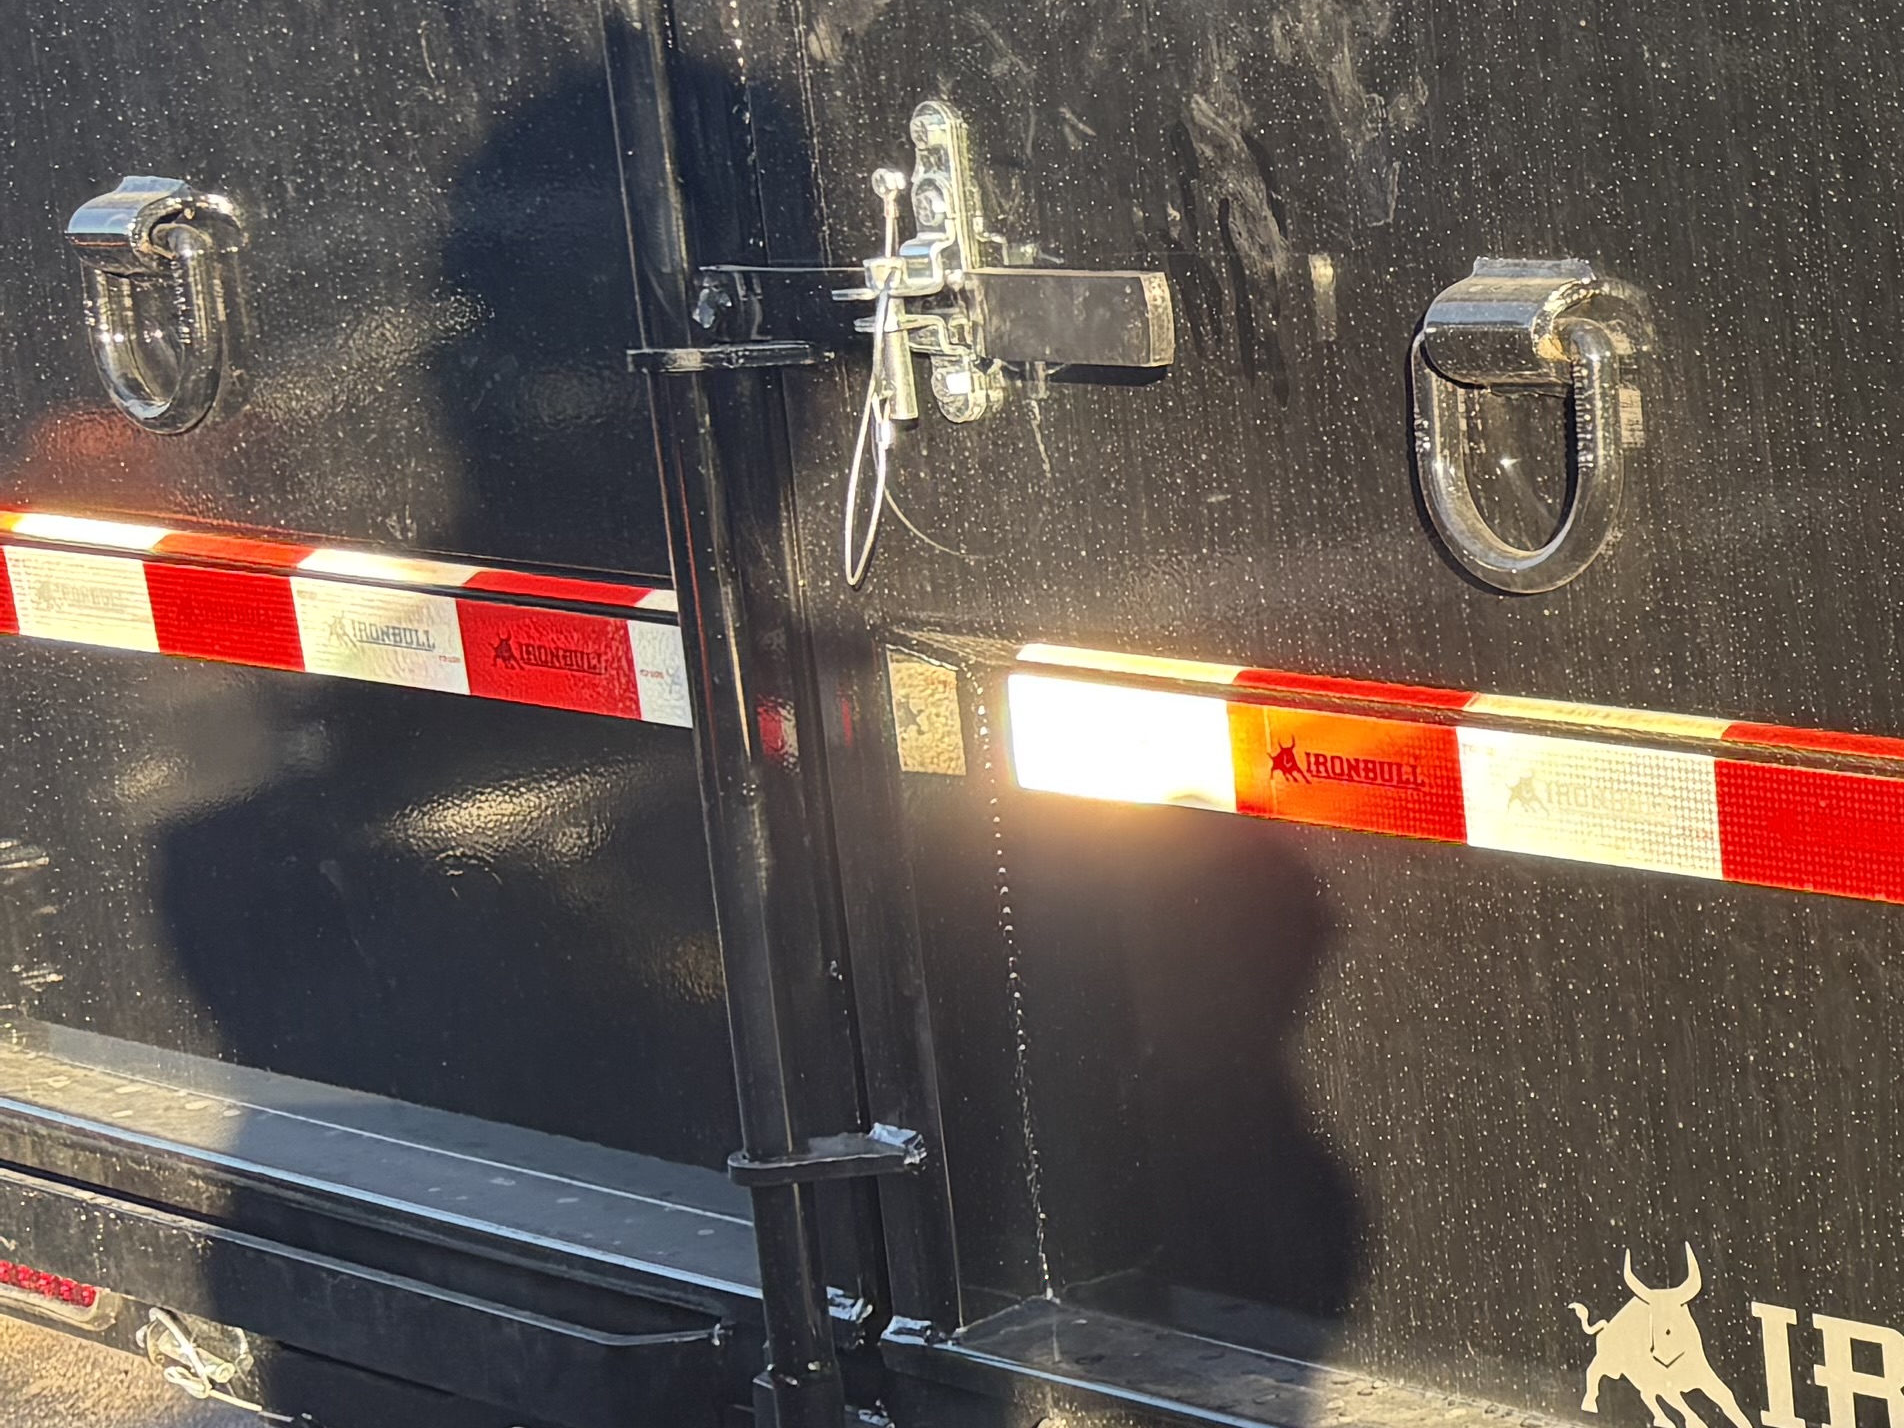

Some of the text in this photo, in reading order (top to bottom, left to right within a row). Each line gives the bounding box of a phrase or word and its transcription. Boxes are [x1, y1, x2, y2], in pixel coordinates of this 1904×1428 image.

[351, 620, 436, 650] IRONBULL
[518, 641, 607, 672] IRONBULL
[1305, 751, 1426, 787] IRONBULL
